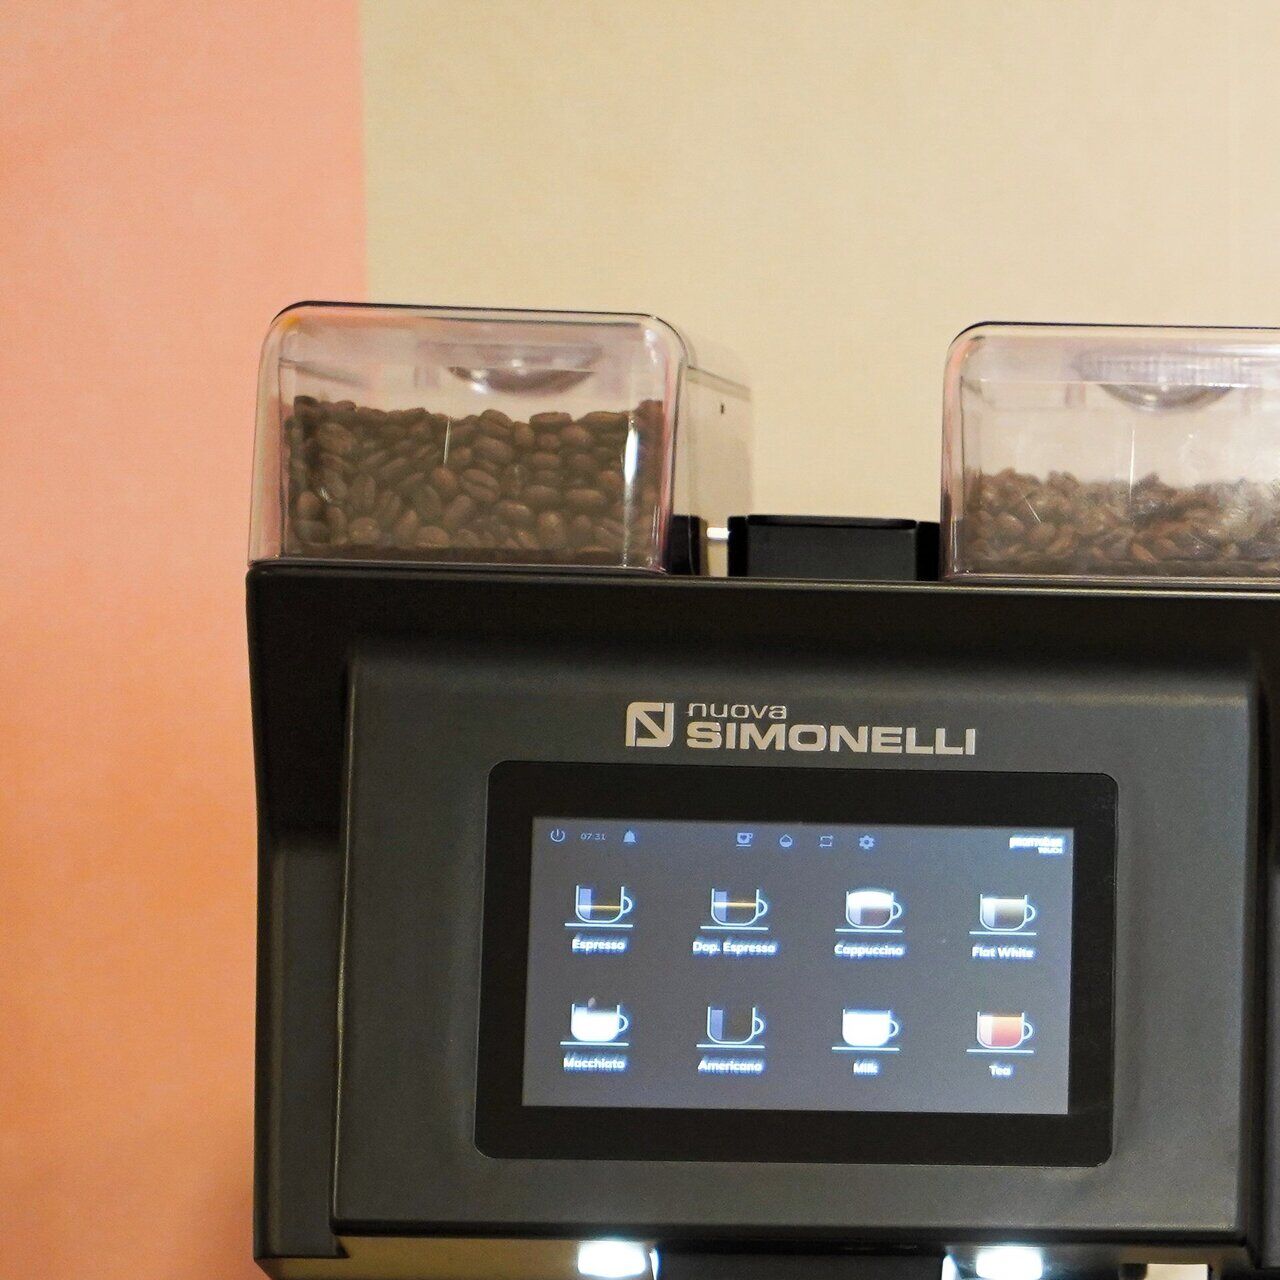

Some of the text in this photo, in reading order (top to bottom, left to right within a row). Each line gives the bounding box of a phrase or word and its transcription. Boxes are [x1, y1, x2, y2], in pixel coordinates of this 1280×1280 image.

[687, 702, 787, 720] nuova
[686, 721, 976, 756] SIMONELLI
[580, 832, 606, 841] 0731
[572, 939, 625, 954] Espresso
[723, 941, 776, 955] Espresso
[834, 944, 904, 957] Cappuccino
[972, 946, 1034, 958] Flat White
[563, 1056, 626, 1070] Macchiato
[698, 1059, 763, 1072] Americano
[853, 1062, 878, 1074] Milk
[989, 1065, 1012, 1076] Tea
